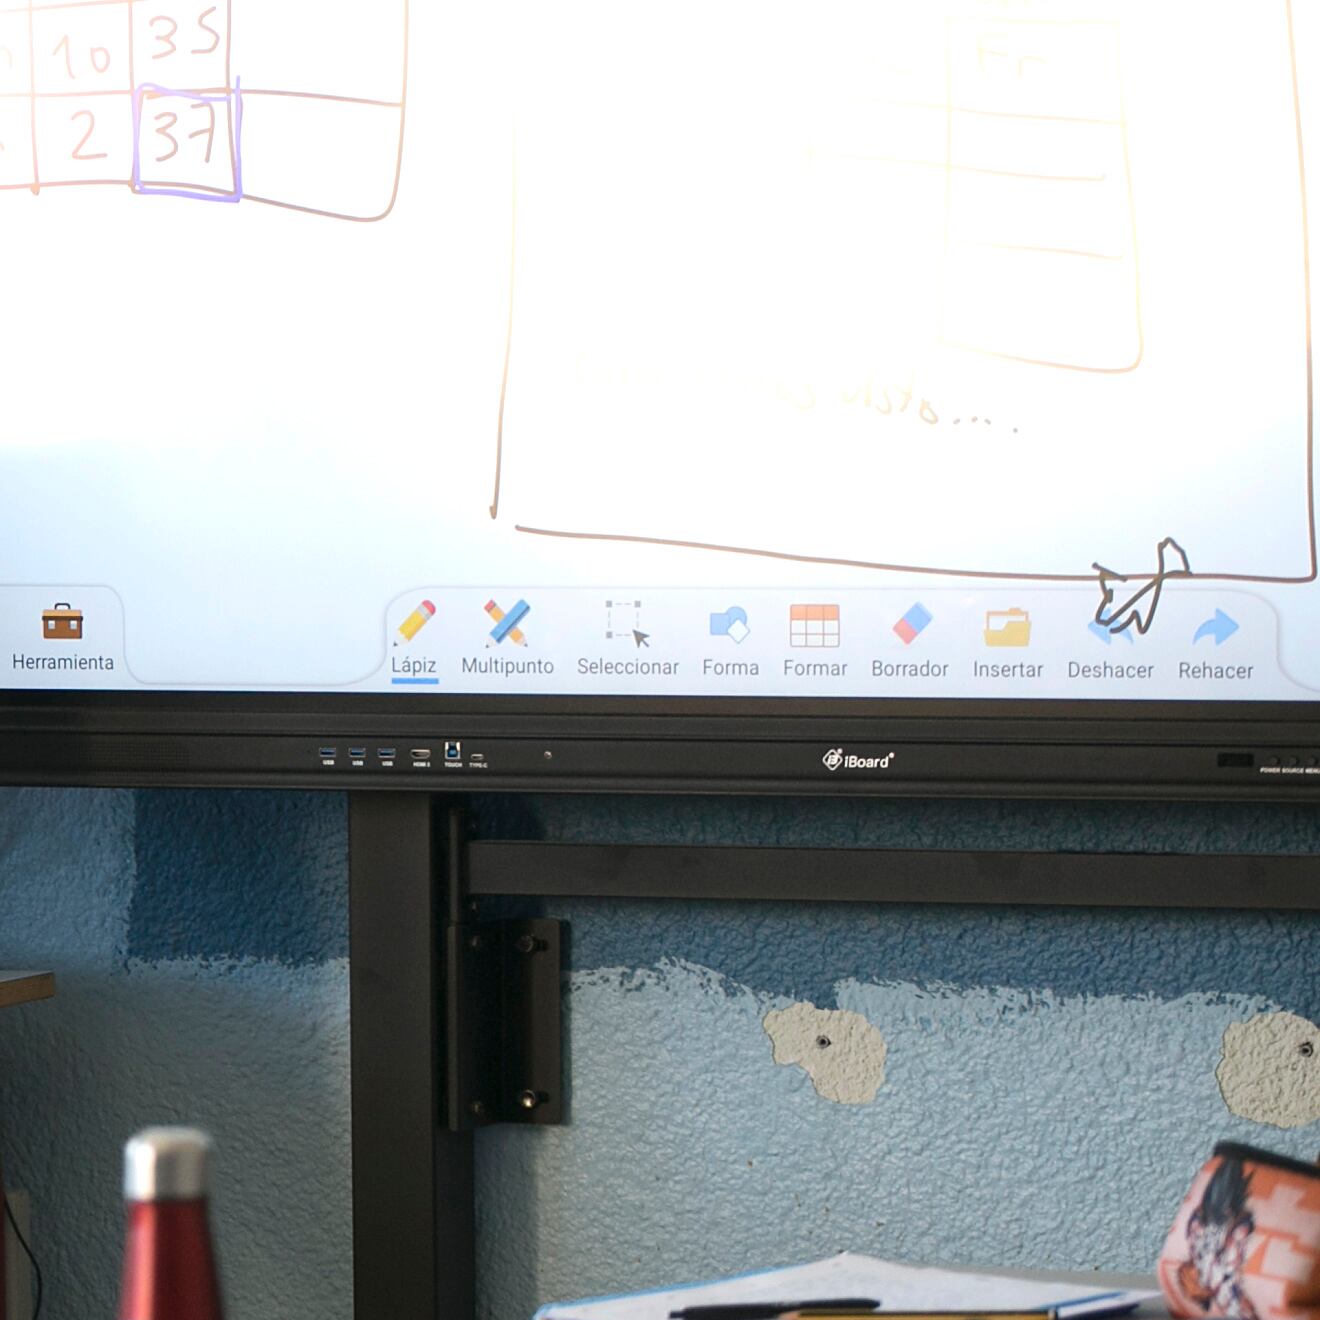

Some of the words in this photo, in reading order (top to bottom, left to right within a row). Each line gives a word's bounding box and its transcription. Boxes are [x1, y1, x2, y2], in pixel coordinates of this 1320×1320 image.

[52, 34, 111, 80] 10
[148, 6, 220, 59] 35
[70, 110, 108, 160] 2
[153, 99, 216, 163] 37
[12, 654, 114, 671] Herramienta
[391, 655, 437, 677] Lápiz
[462, 657, 554, 677] Multipunto
[577, 658, 680, 675] Seleccionar
[703, 659, 759, 676] Forma
[784, 660, 848, 677] Formar
[872, 660, 949, 677] Borrador
[974, 661, 1044, 678] Insertar
[1068, 661, 1155, 679] Deshacer
[1179, 662, 1254, 680] Rehacer
[844, 754, 891, 769] iBoard
